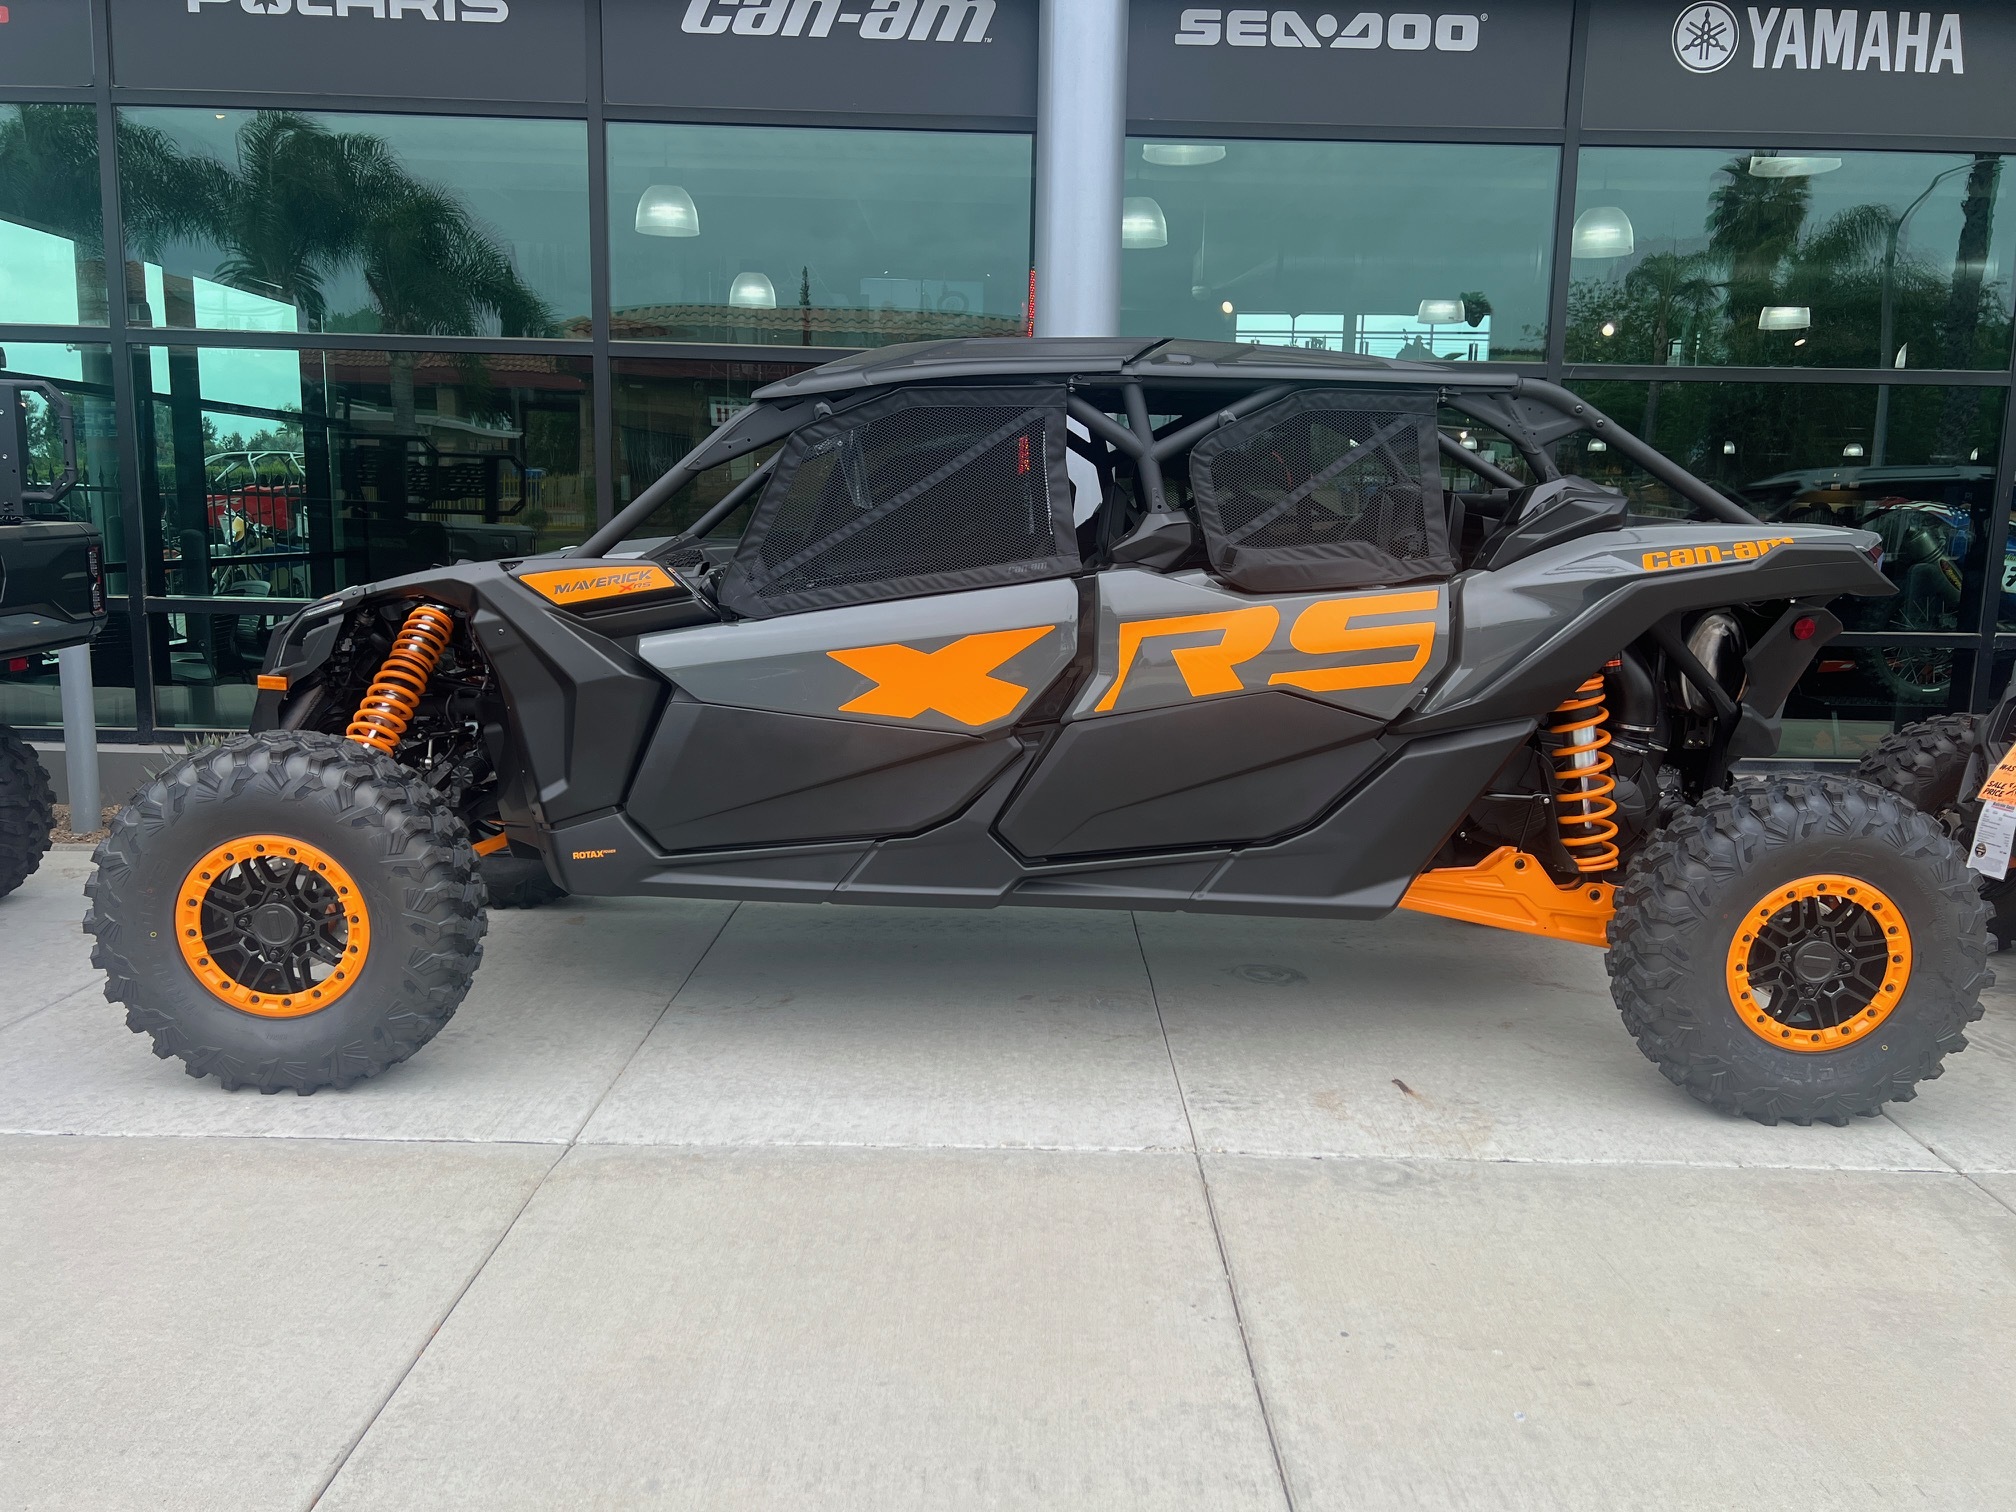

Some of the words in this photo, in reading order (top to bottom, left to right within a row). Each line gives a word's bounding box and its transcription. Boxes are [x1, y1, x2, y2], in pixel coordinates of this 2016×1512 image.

[1747, 6, 1964, 75] YAMAHA
[554, 569, 653, 594] MAVERICK
[1987, 781, 2007, 790] SALE
[1983, 787, 2004, 797] PRICE
[572, 850, 604, 860] ROTAX
